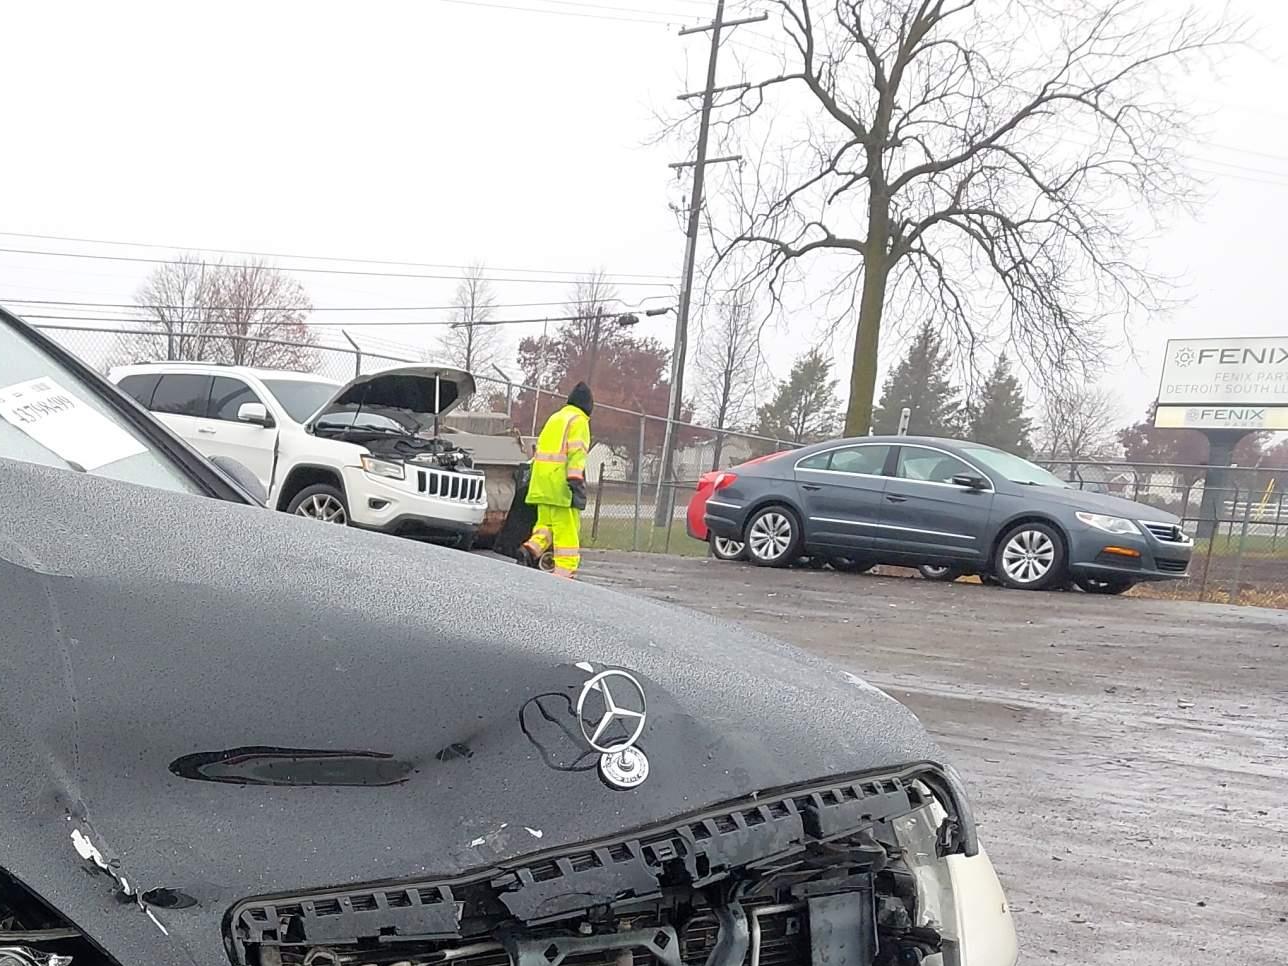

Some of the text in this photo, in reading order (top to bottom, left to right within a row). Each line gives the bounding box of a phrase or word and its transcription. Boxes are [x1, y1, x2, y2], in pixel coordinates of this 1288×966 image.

[1198, 347, 1288, 364] FENIX
[1166, 384, 1220, 394] DETROIT
[1225, 384, 1269, 394] SOUTH
[1201, 409, 1265, 420] FENIX
